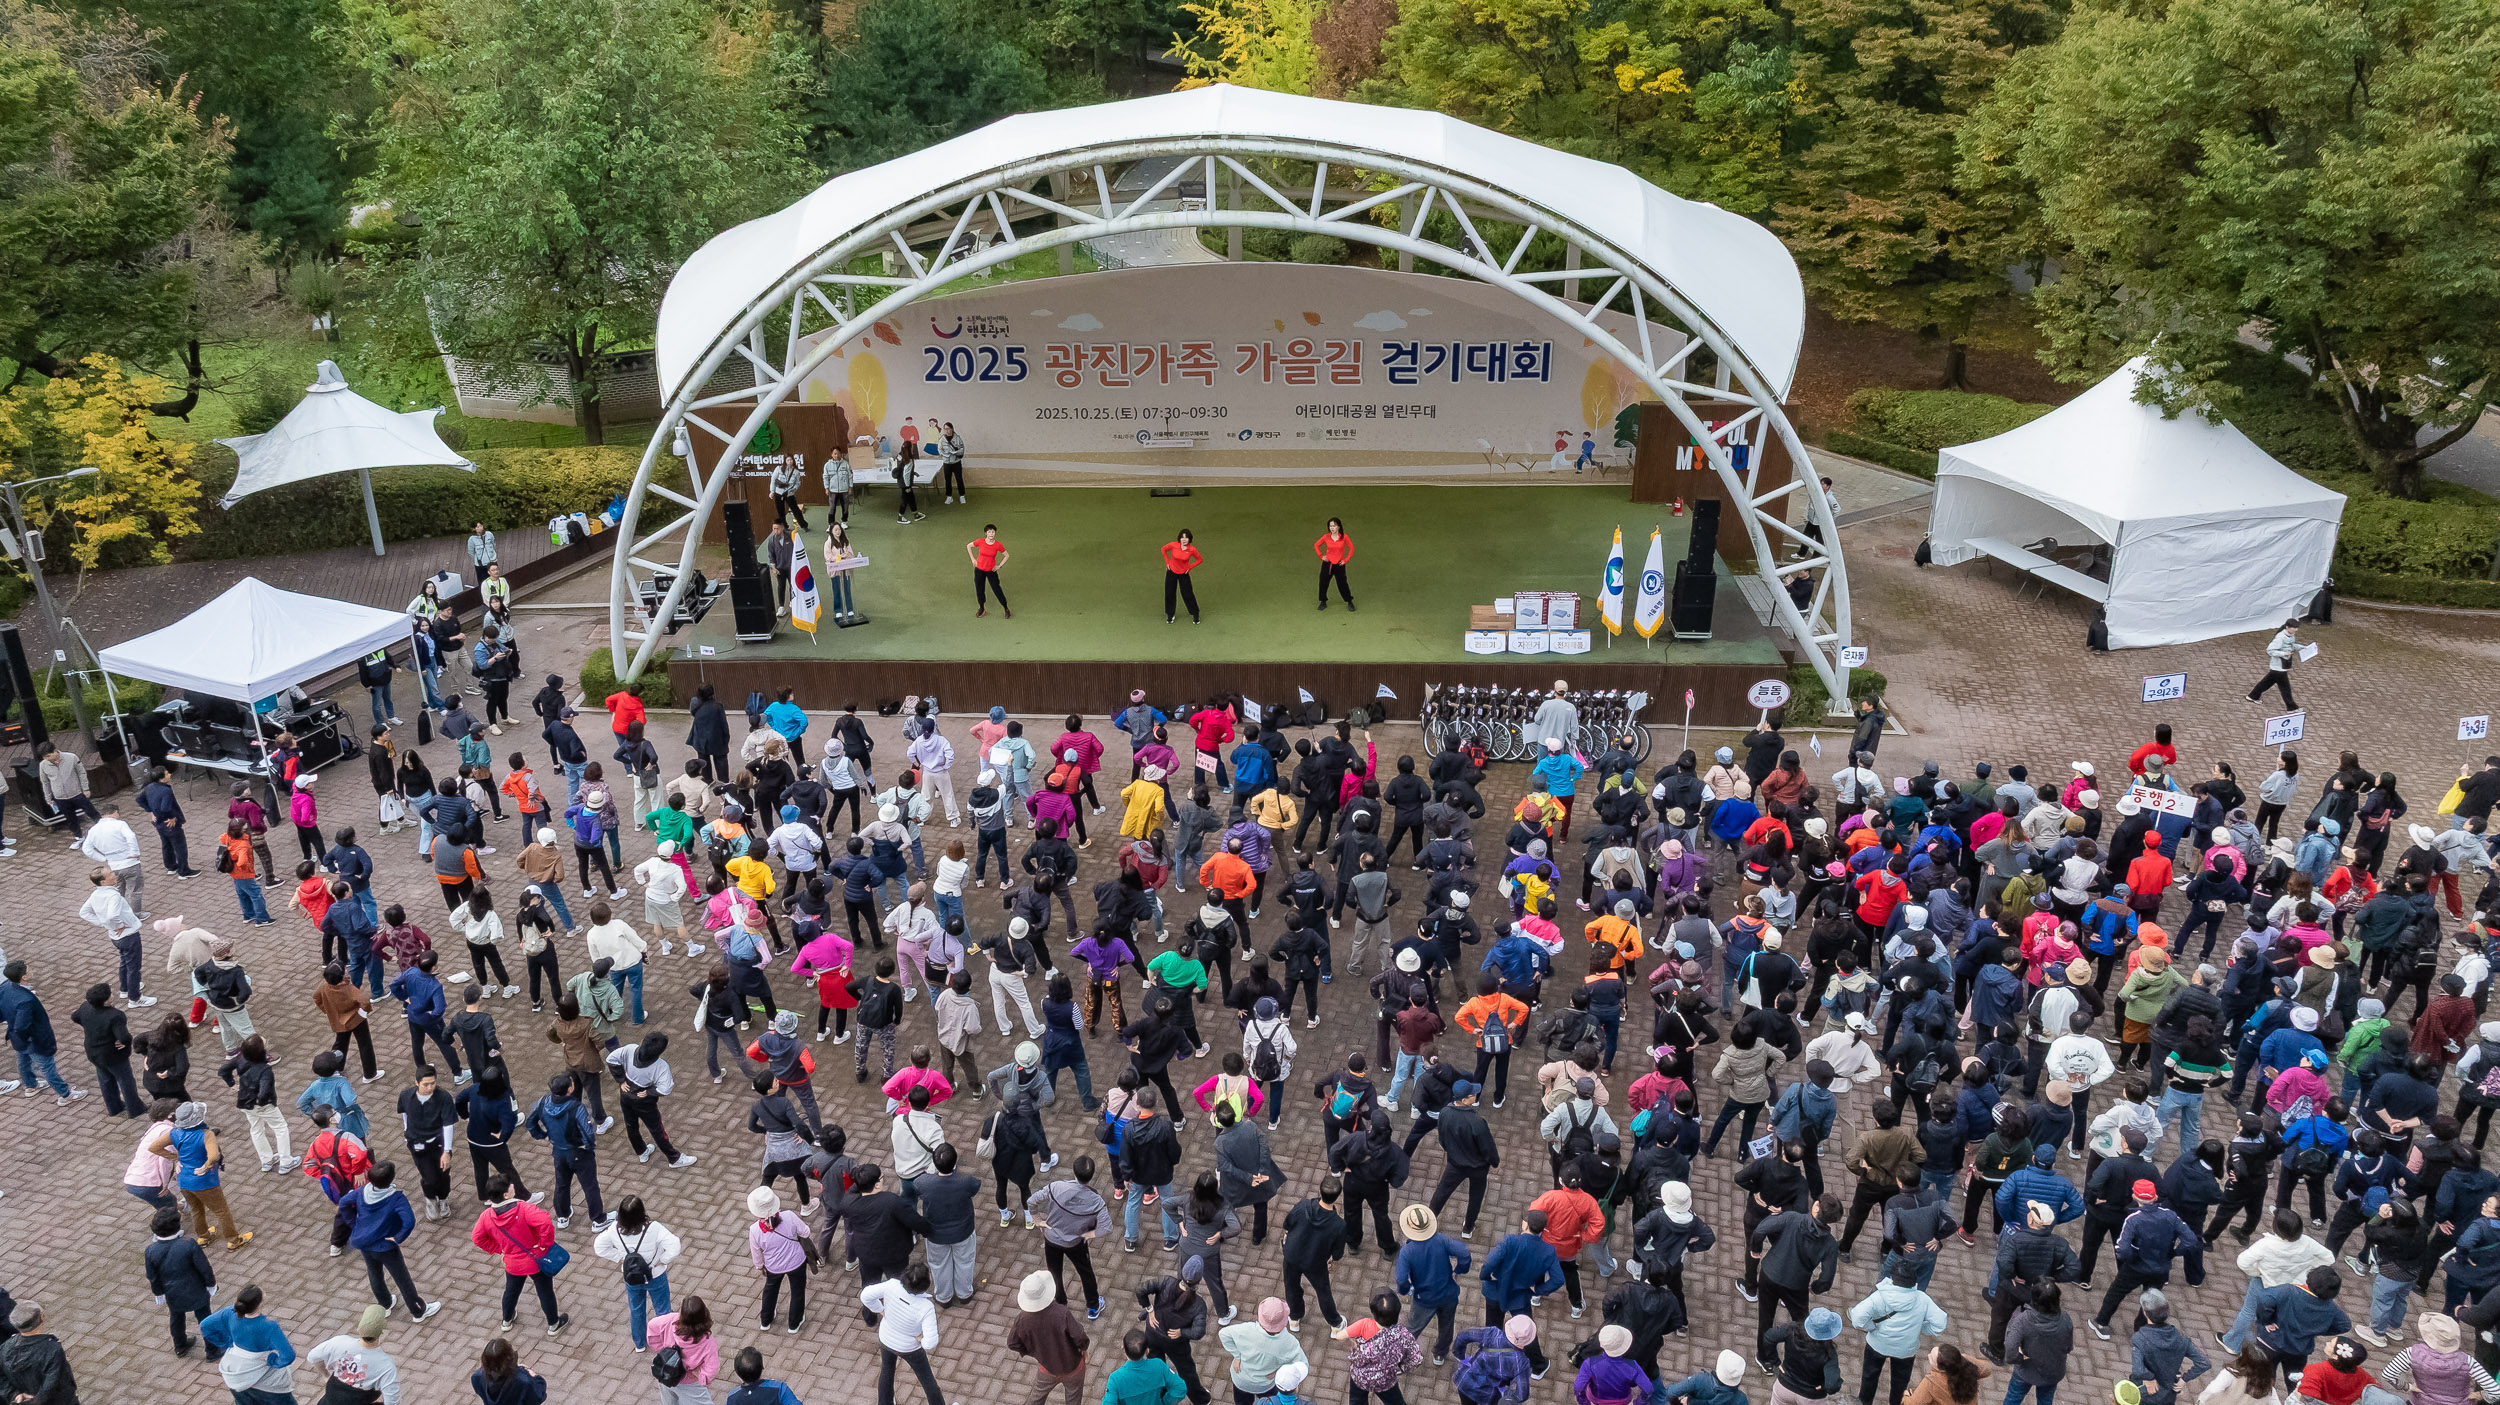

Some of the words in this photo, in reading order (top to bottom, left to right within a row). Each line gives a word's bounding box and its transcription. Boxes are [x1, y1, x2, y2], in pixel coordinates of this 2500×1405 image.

[967, 323, 1010, 339] 행복광진
[923, 345, 1028, 383] 2025
[1044, 342, 1220, 388] 광진가족
[1234, 339, 1363, 385] 가을길
[1380, 339, 1553, 385] 걷기대회
[1035, 406, 1138, 420] 2025.10.25.(토)
[1142, 406, 1228, 419] 07:30~09:30
[1295, 404, 1377, 419] 어린이대공원
[1382, 404, 1437, 419] 열린무대
[1255, 431, 1281, 439] 광진구
[1843, 650, 1865, 660] 군자동
[1758, 685, 1782, 696] 능동
[2147, 686, 2180, 699] 구의2동
[2269, 726, 2300, 739] 구의3동
